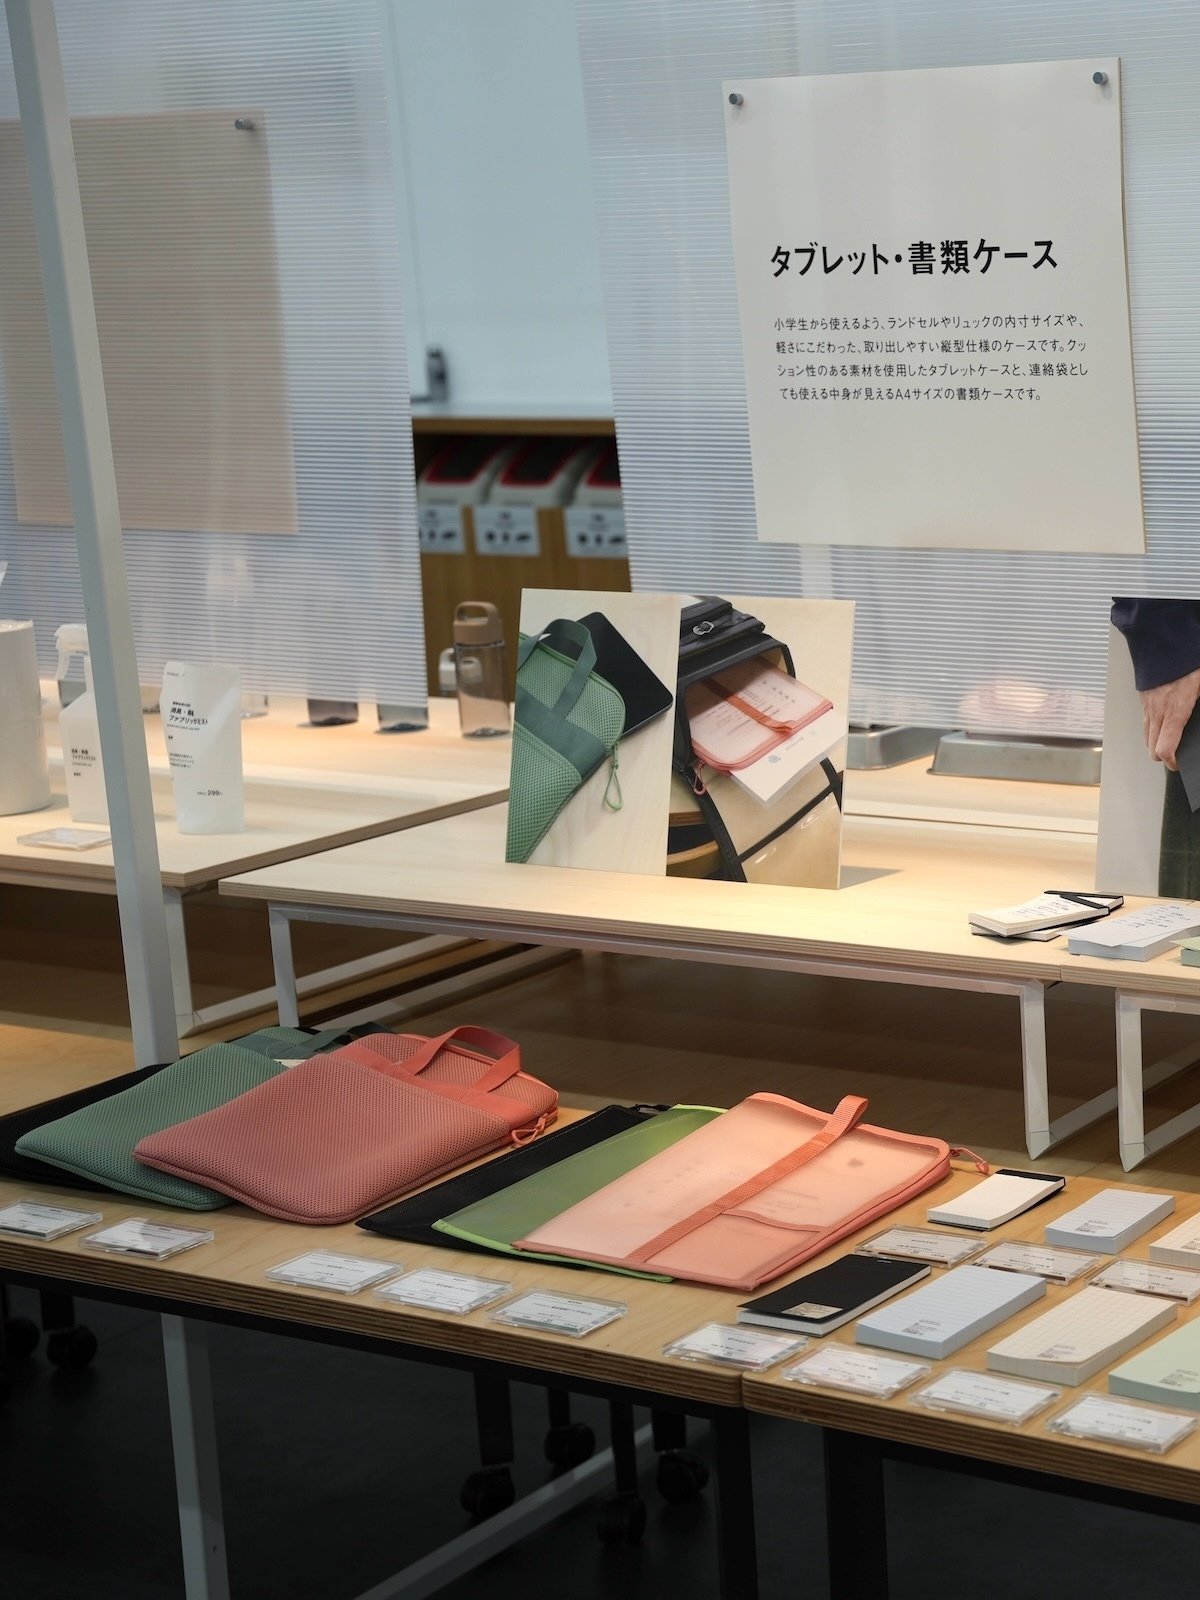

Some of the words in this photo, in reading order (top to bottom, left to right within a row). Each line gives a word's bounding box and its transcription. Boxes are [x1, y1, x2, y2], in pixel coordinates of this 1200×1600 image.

[770, 237, 1058, 277] タブレット・書類ケース
[773, 313, 1084, 331] 小学生から使えるよう、ランドセルやリュックの内寸サイズや、
[775, 338, 1087, 355] 軽さにこだわった、取り出しやすい縦型仕様のケースです。クッ
[777, 362, 1089, 378] ション性のある素材を使用したタブレットケースと、連絡袋とし
[779, 386, 1041, 401] ても使える中身が見えるA4サイズの書類ケースです。
